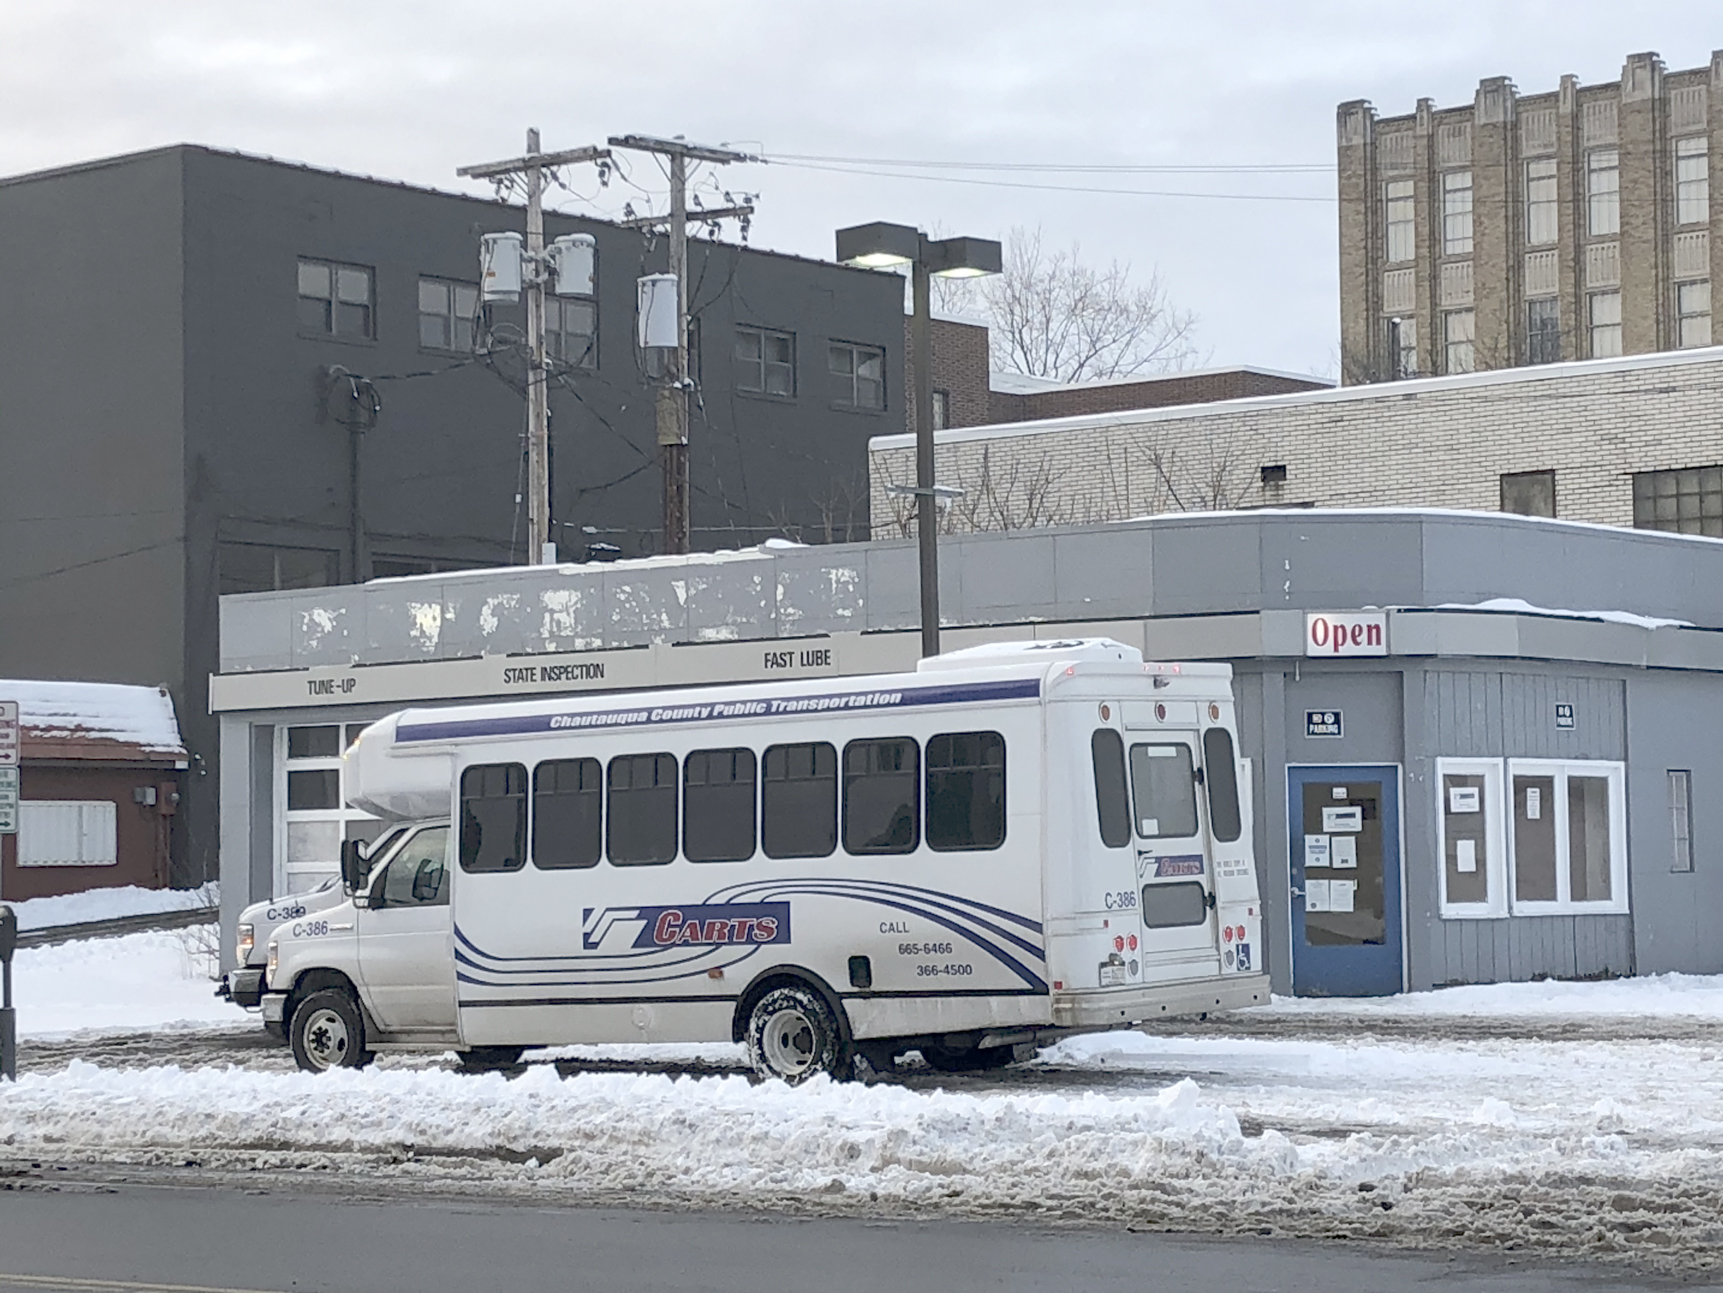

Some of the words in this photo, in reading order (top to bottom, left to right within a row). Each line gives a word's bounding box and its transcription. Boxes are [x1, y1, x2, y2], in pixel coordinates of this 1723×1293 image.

[1311, 617, 1382, 654] Open
[764, 651, 795, 669] FAST
[800, 649, 831, 667] LUBE
[503, 667, 537, 684] STATE
[540, 663, 605, 682] INSPECTION
[307, 678, 356, 696] TUNE-UP
[549, 711, 649, 728] Chautauqua
[650, 705, 711, 721] County
[713, 702, 768, 716] Public
[770, 692, 903, 713] Transportation
[1105, 890, 1137, 909] C-386
[292, 920, 328, 938] C-386
[879, 921, 910, 934] CALL
[898, 943, 953, 956] 665-6466
[916, 963, 973, 977] 366-4500
